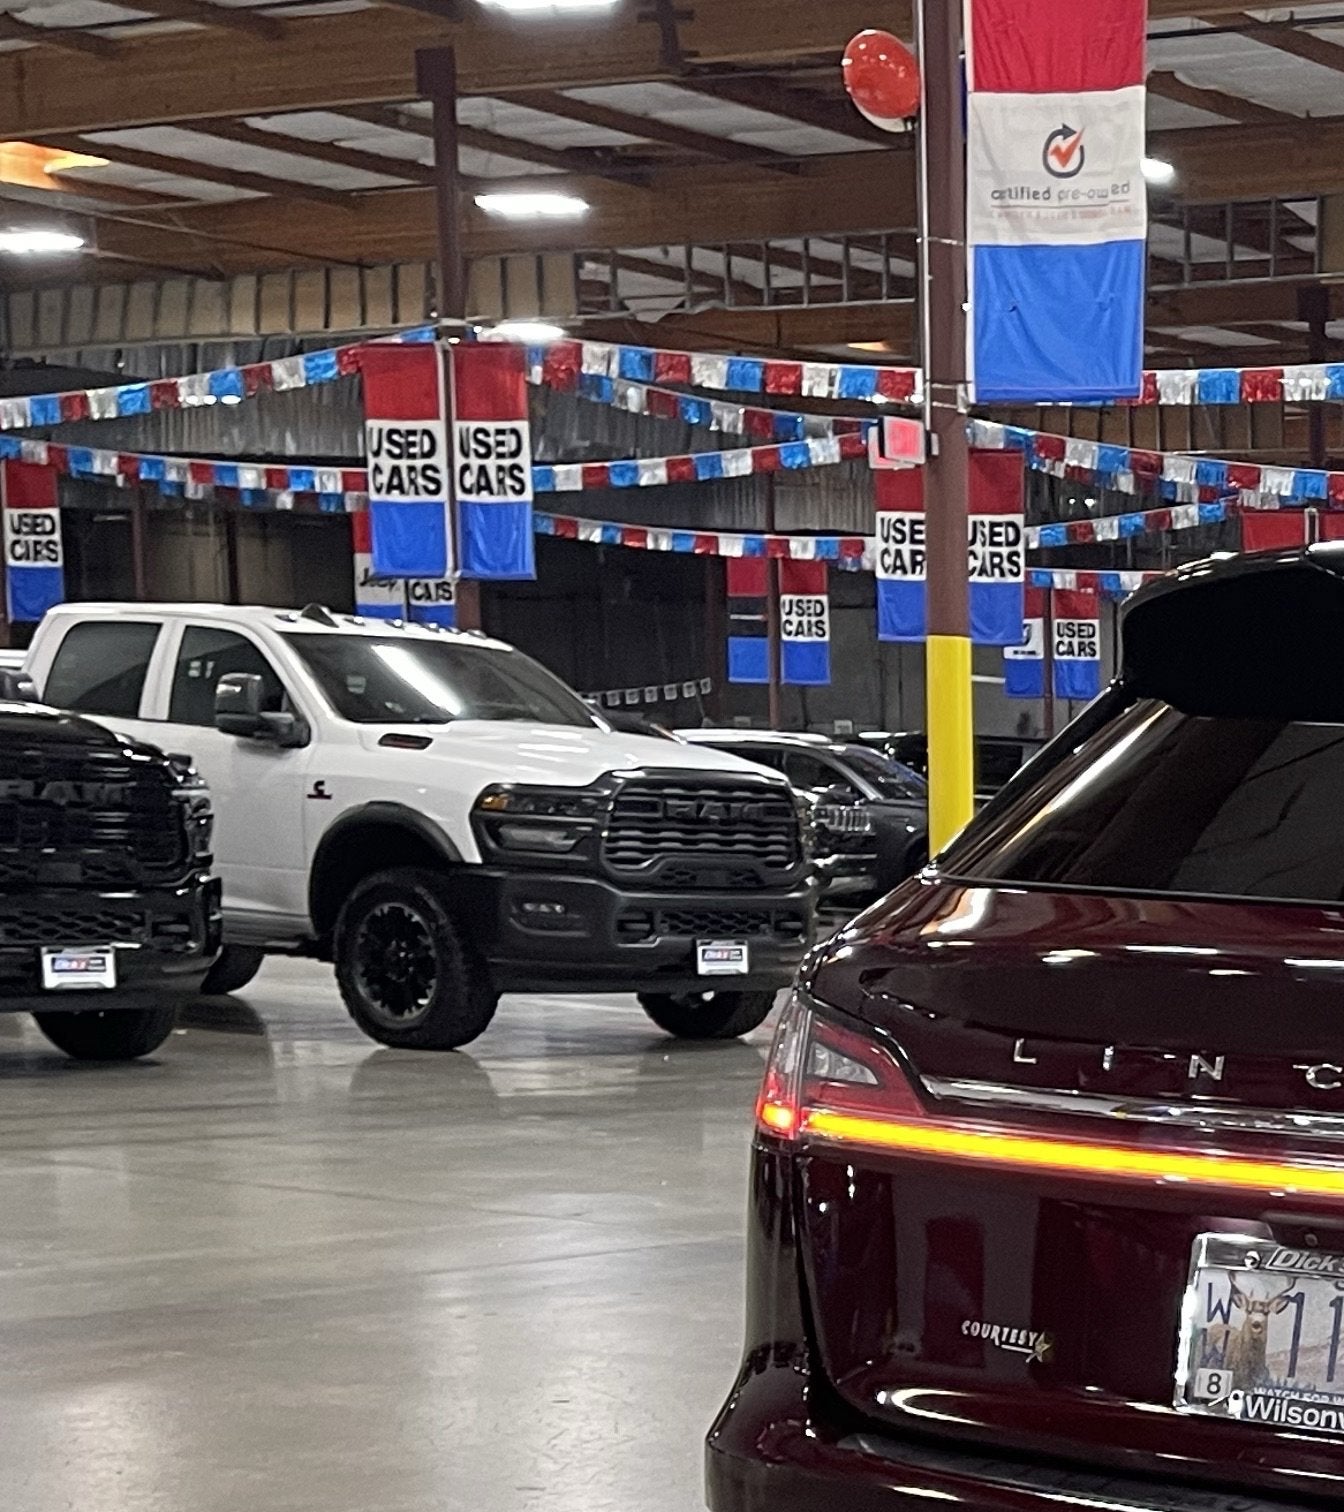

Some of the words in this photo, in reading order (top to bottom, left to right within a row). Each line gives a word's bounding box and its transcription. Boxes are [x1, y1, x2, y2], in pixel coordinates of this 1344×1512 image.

[369, 427, 436, 459] USED
[458, 426, 522, 459] USED
[372, 463, 442, 495] CARS
[459, 463, 525, 495] CARS
[9, 513, 56, 535] USED
[880, 517, 925, 545] USE
[880, 547, 925, 575] CAR
[782, 599, 825, 617] USED
[1056, 622, 1096, 638] USED
[1056, 641, 1097, 657] CARS
[961, 1320, 1038, 1346] COURTESY
[1206, 1372, 1222, 1395] 8
